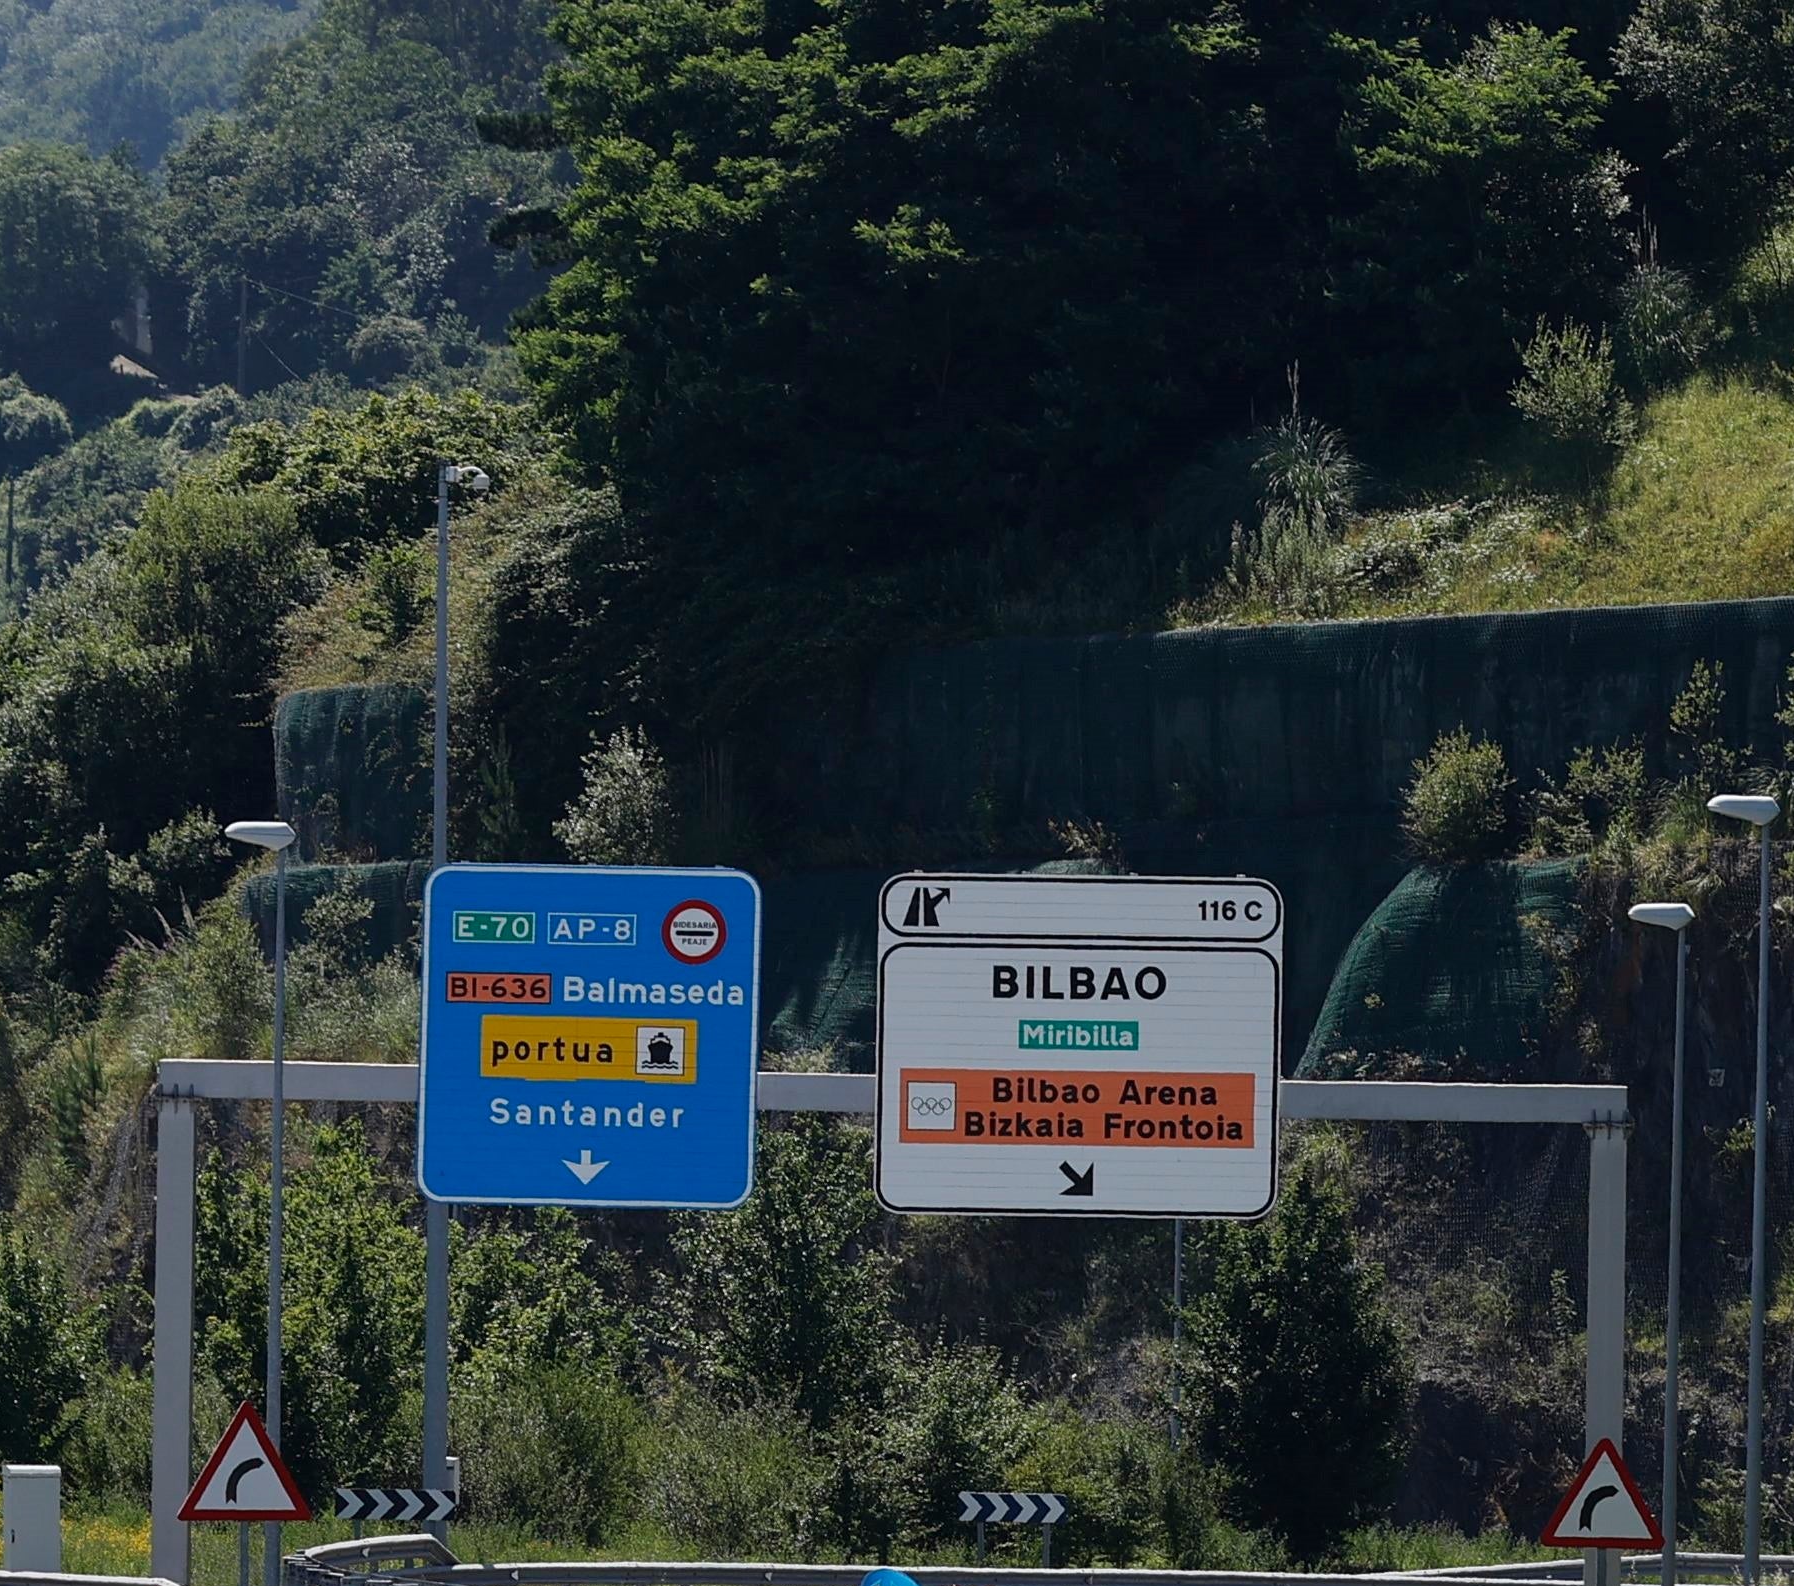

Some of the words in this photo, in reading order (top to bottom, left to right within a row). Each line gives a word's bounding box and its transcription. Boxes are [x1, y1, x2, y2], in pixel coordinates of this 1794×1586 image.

[673, 921, 718, 930] BIDESARIA
[1198, 899, 1237, 922] 116
[1244, 900, 1263, 922] C
[458, 917, 530, 938] E-70
[553, 919, 632, 940] AP-8
[681, 938, 708, 946] PEAJE
[450, 977, 547, 999] BI-636
[563, 976, 744, 1006] Balmaseda
[992, 964, 1167, 1001] BILBAO
[1022, 1023, 1134, 1047] Miribilla
[492, 1037, 614, 1067] portua
[992, 1076, 1101, 1105] Bilbao
[1118, 1079, 1218, 1106] Arena
[489, 1097, 685, 1128] Santander
[964, 1110, 1085, 1139] Bizkaia
[1104, 1113, 1244, 1141] Frontoia
